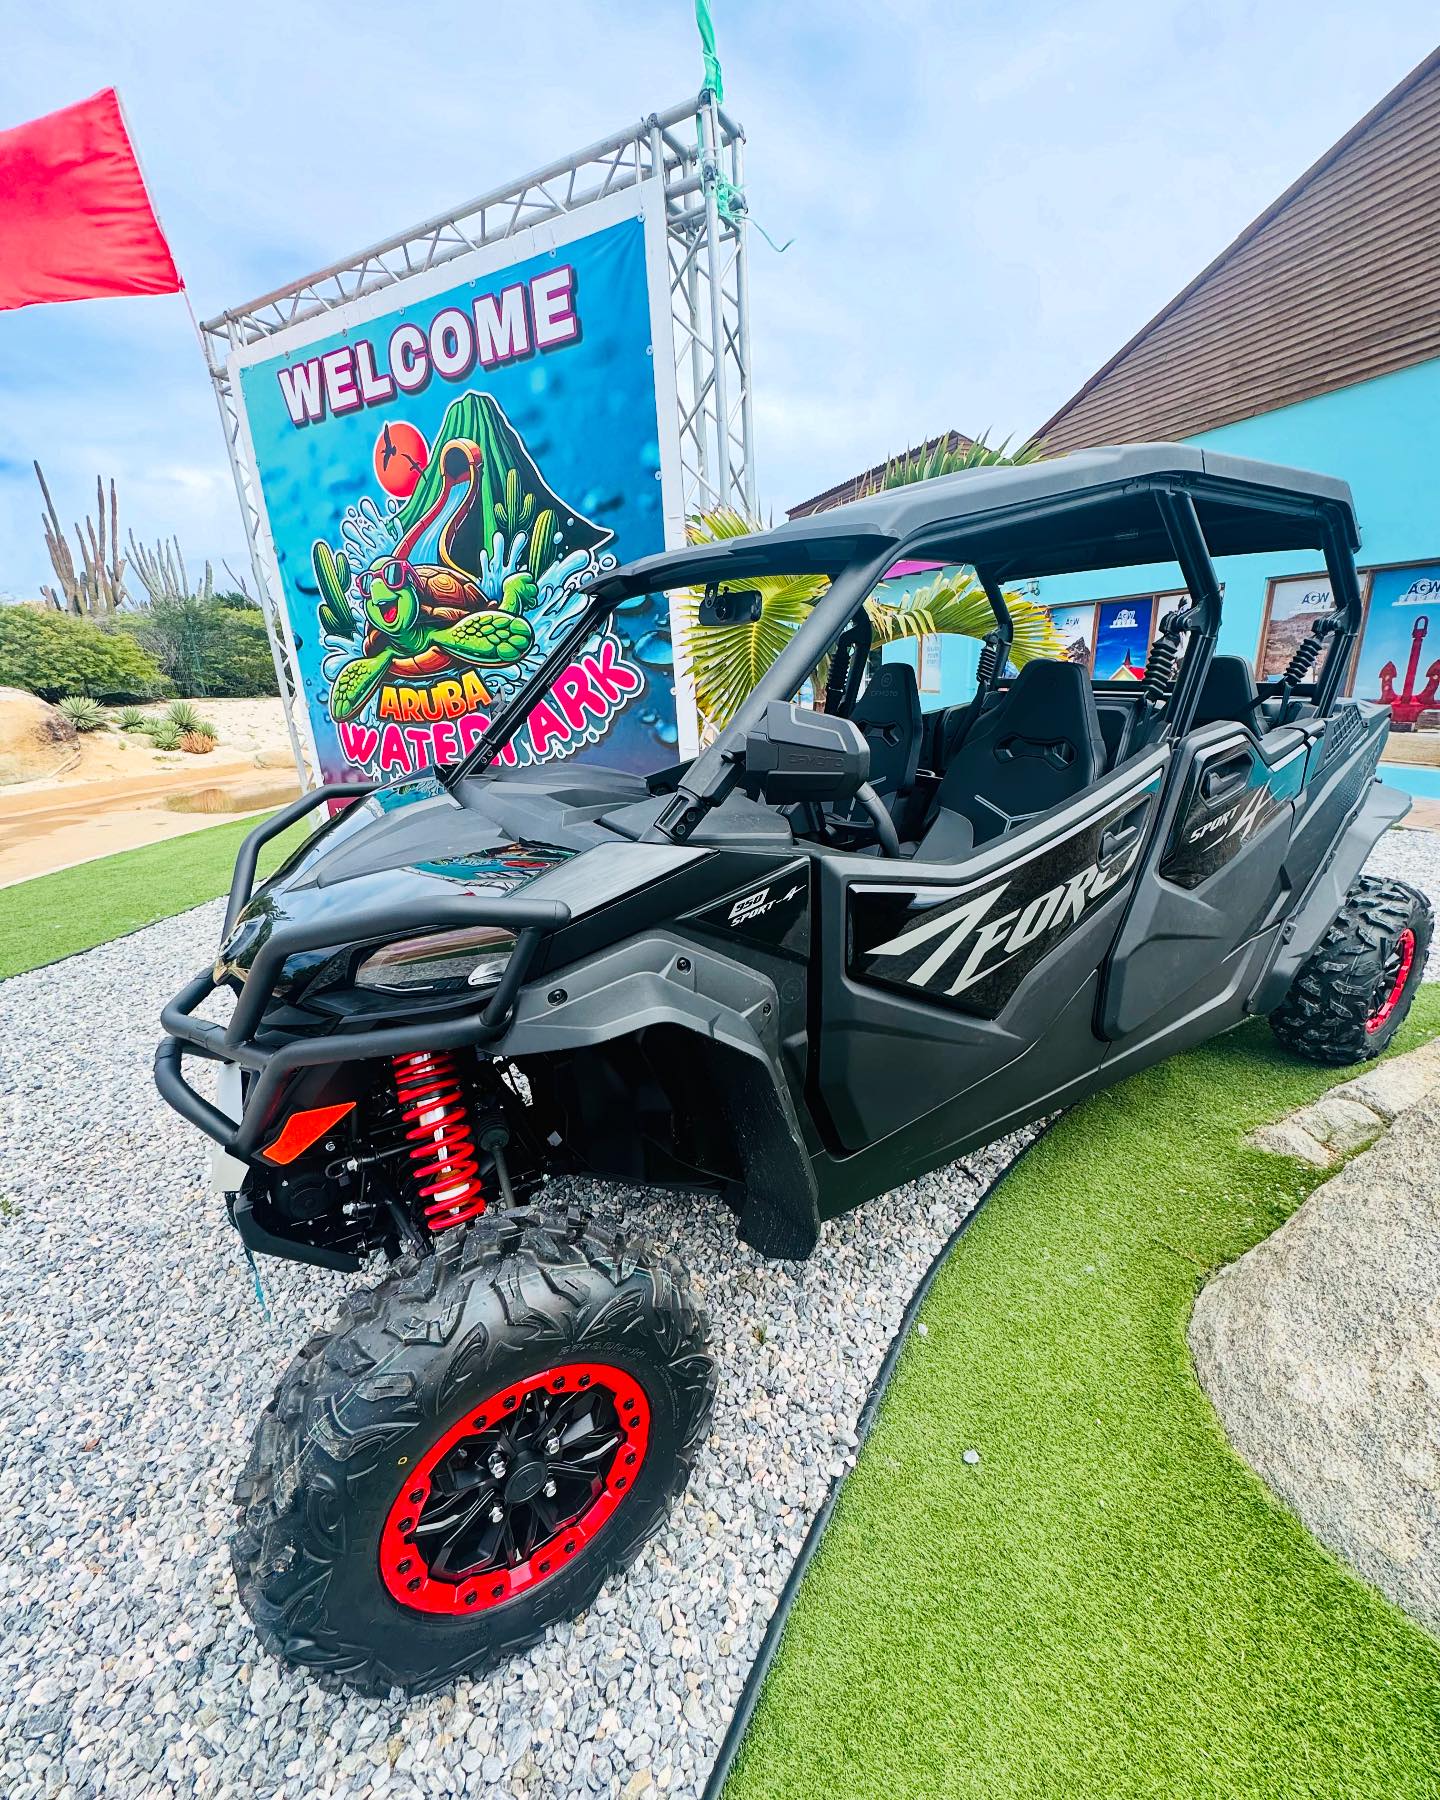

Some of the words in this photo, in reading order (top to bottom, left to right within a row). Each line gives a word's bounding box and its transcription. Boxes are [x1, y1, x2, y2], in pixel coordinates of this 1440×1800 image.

[277, 265, 578, 425] WELCOME
[339, 641, 638, 773] WATERARK
[380, 670, 493, 723] ARUBA
[1189, 803, 1241, 844] SPORT
[731, 889, 767, 916] 950
